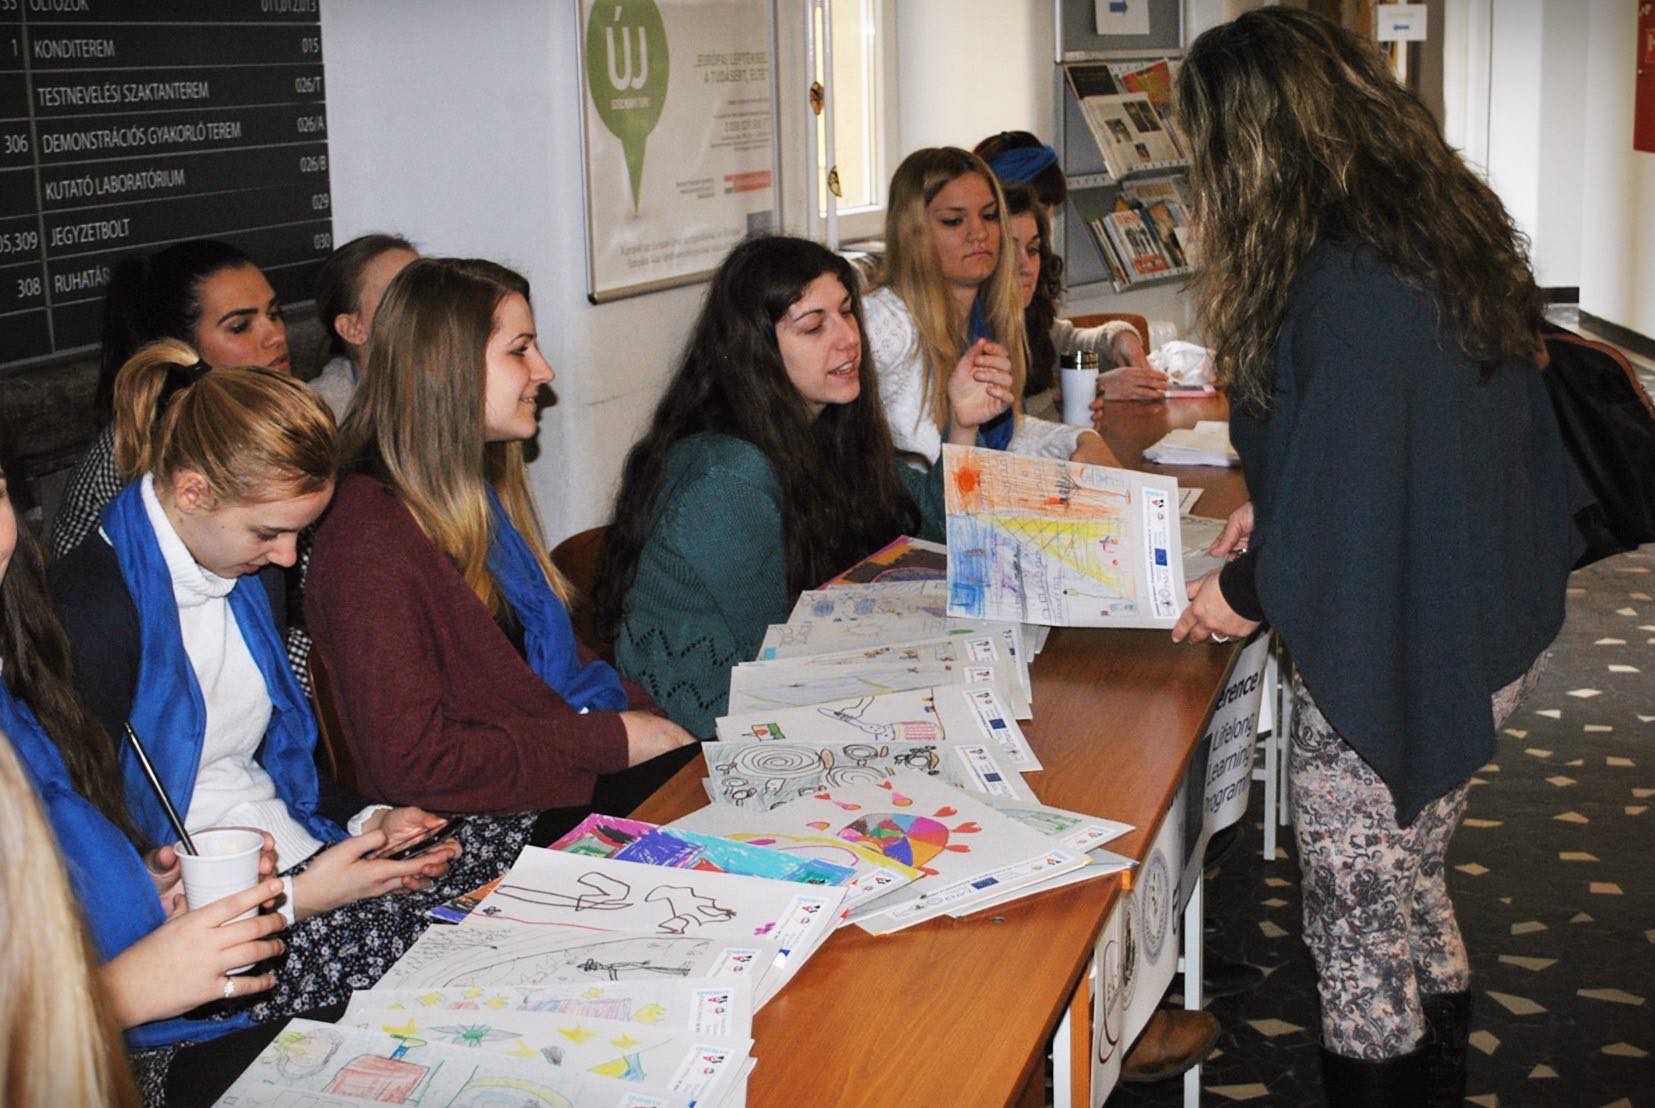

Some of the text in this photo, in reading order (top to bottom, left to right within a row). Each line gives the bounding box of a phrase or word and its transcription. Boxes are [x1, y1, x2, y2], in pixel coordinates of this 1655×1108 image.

[33, 39, 116, 59] KONDITEREM
[301, 37, 320, 54] 015
[606, 6, 649, 91] ÚJ
[38, 81, 210, 107] TESTNEVELÉSI SZAKTANTEREM
[295, 76, 322, 94] 026/T
[297, 116, 326, 134] 026/A
[5, 134, 29, 154] 306
[42, 121, 242, 154] DEMONSTRÁCIÓS GYAKORLÓ TEREM
[300, 155, 327, 173] 026/B
[45, 167, 186, 201] KUTATÓ LABORATÓRIUM
[312, 194, 330, 210] 029
[50, 218, 130, 247] JEGYZETBOLT
[313, 234, 331, 250] 030
[17, 277, 41, 298] 308
[1212, 713, 1255, 752] Lifelong
[1207, 744, 1252, 787] Learning
